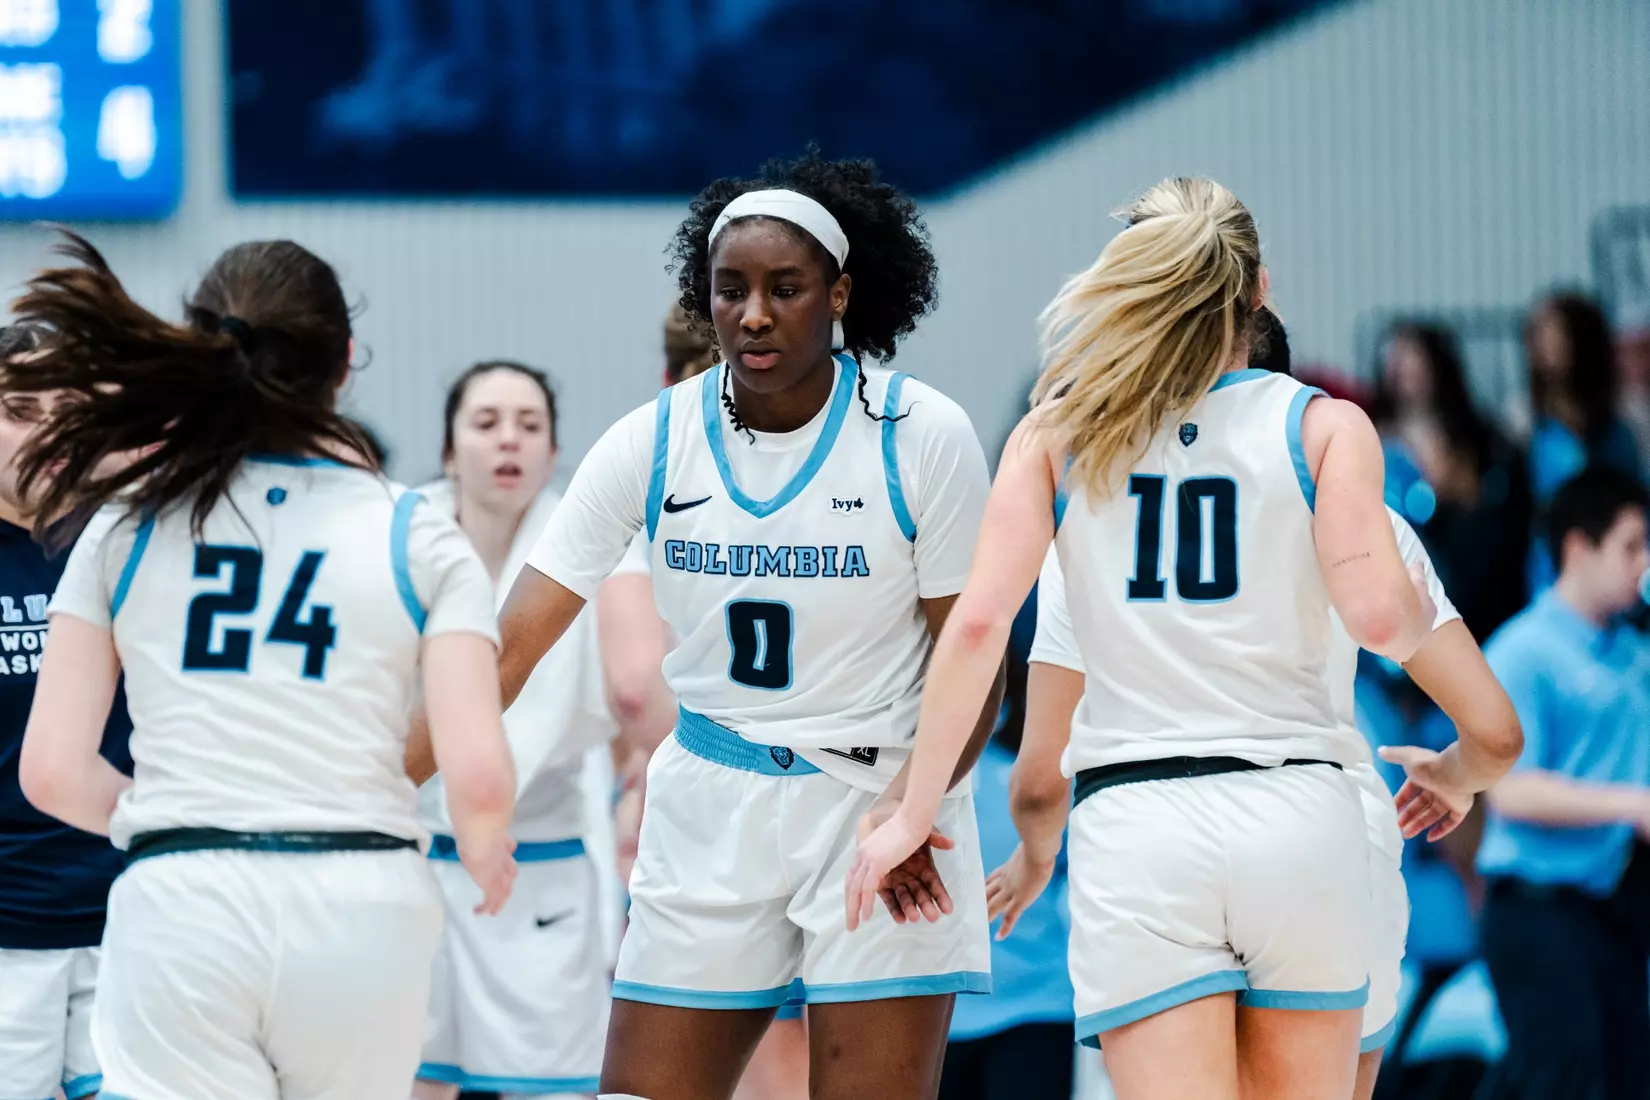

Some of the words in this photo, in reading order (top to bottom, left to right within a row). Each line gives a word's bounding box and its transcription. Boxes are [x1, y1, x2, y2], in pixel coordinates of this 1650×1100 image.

[831, 498, 853, 512] Ivy
[1126, 473, 1240, 605] 10
[664, 539, 870, 578] COLUMBIA
[181, 543, 338, 682] 24
[724, 597, 795, 691] 0
